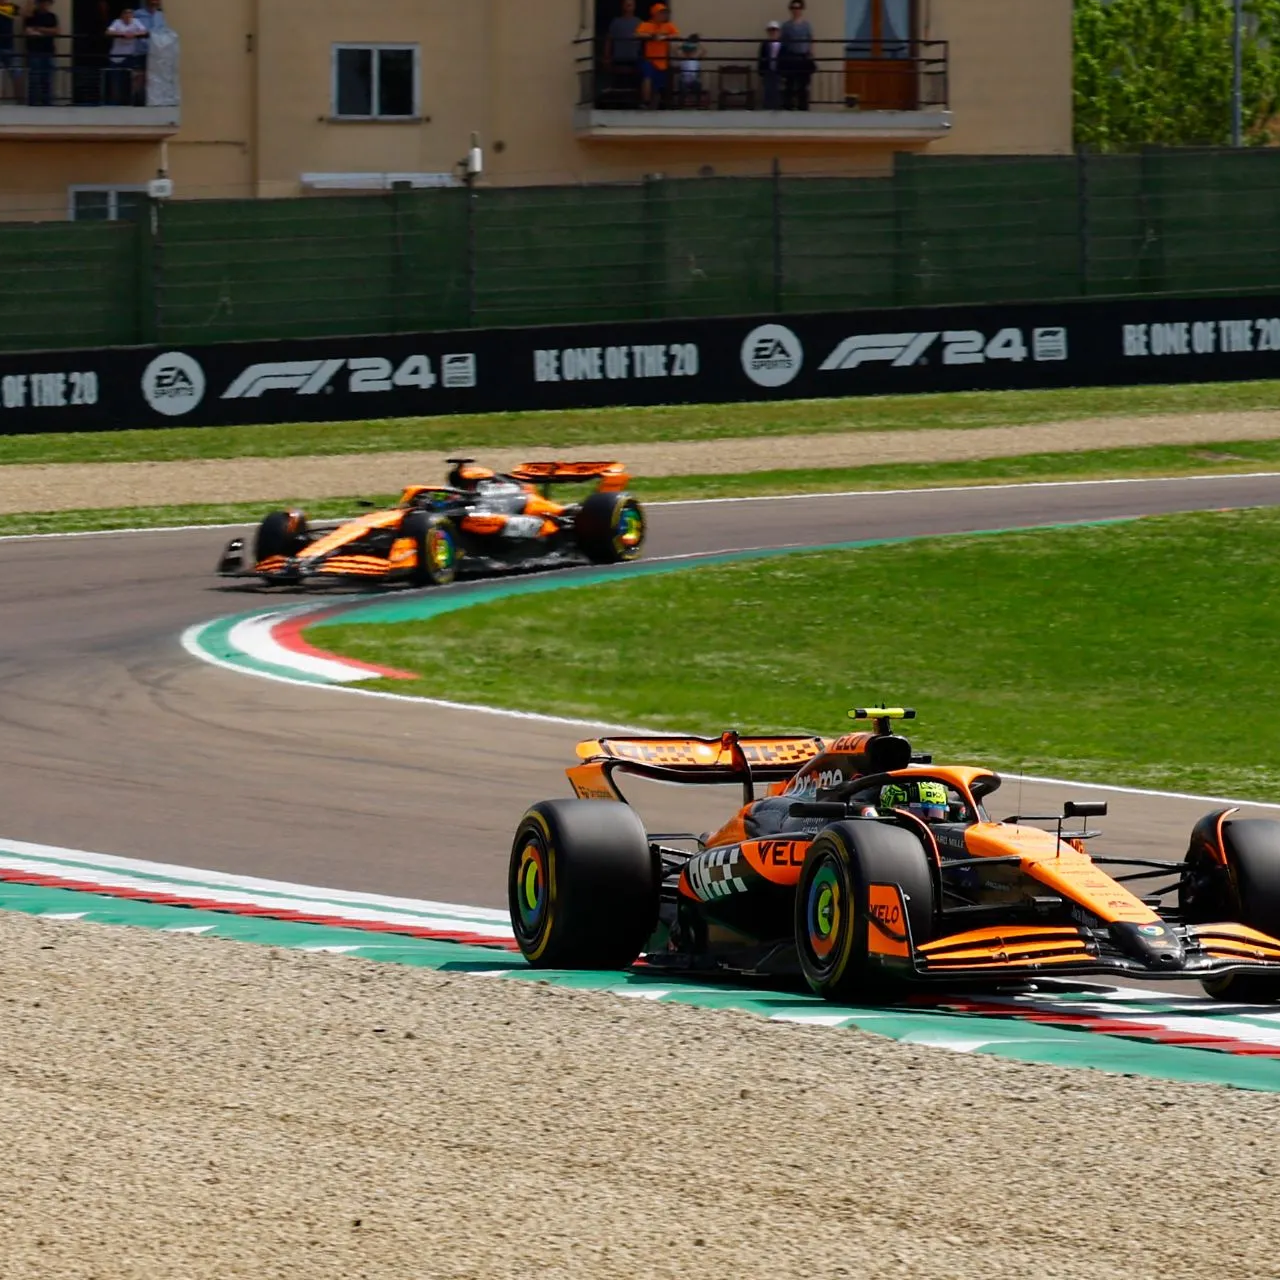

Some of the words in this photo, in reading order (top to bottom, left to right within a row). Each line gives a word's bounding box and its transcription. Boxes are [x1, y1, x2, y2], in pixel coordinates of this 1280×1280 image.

[752, 338, 791, 359] EA
[818, 331, 940, 370] F1
[942, 327, 1027, 365] 24
[1123, 323, 1149, 356] BE
[1150, 322, 1190, 356] ONE
[1192, 321, 1216, 354] OF
[1218, 319, 1253, 353] THE
[153, 367, 193, 387] EA
[220, 358, 346, 399] F1
[347, 354, 436, 393] 24
[534, 349, 560, 382] BE
[561, 347, 603, 381] ONE
[605, 345, 629, 380] OF
[631, 344, 668, 378] THE
[669, 343, 698, 376] 20
[751, 359, 793, 370] SPORTS
[1, 374, 27, 409] OF
[29, 372, 67, 407] THE
[68, 371, 98, 405] 20
[153, 387, 194, 399] SPORTS
[791, 768, 843, 799] hrome
[758, 841, 804, 867] VEL
